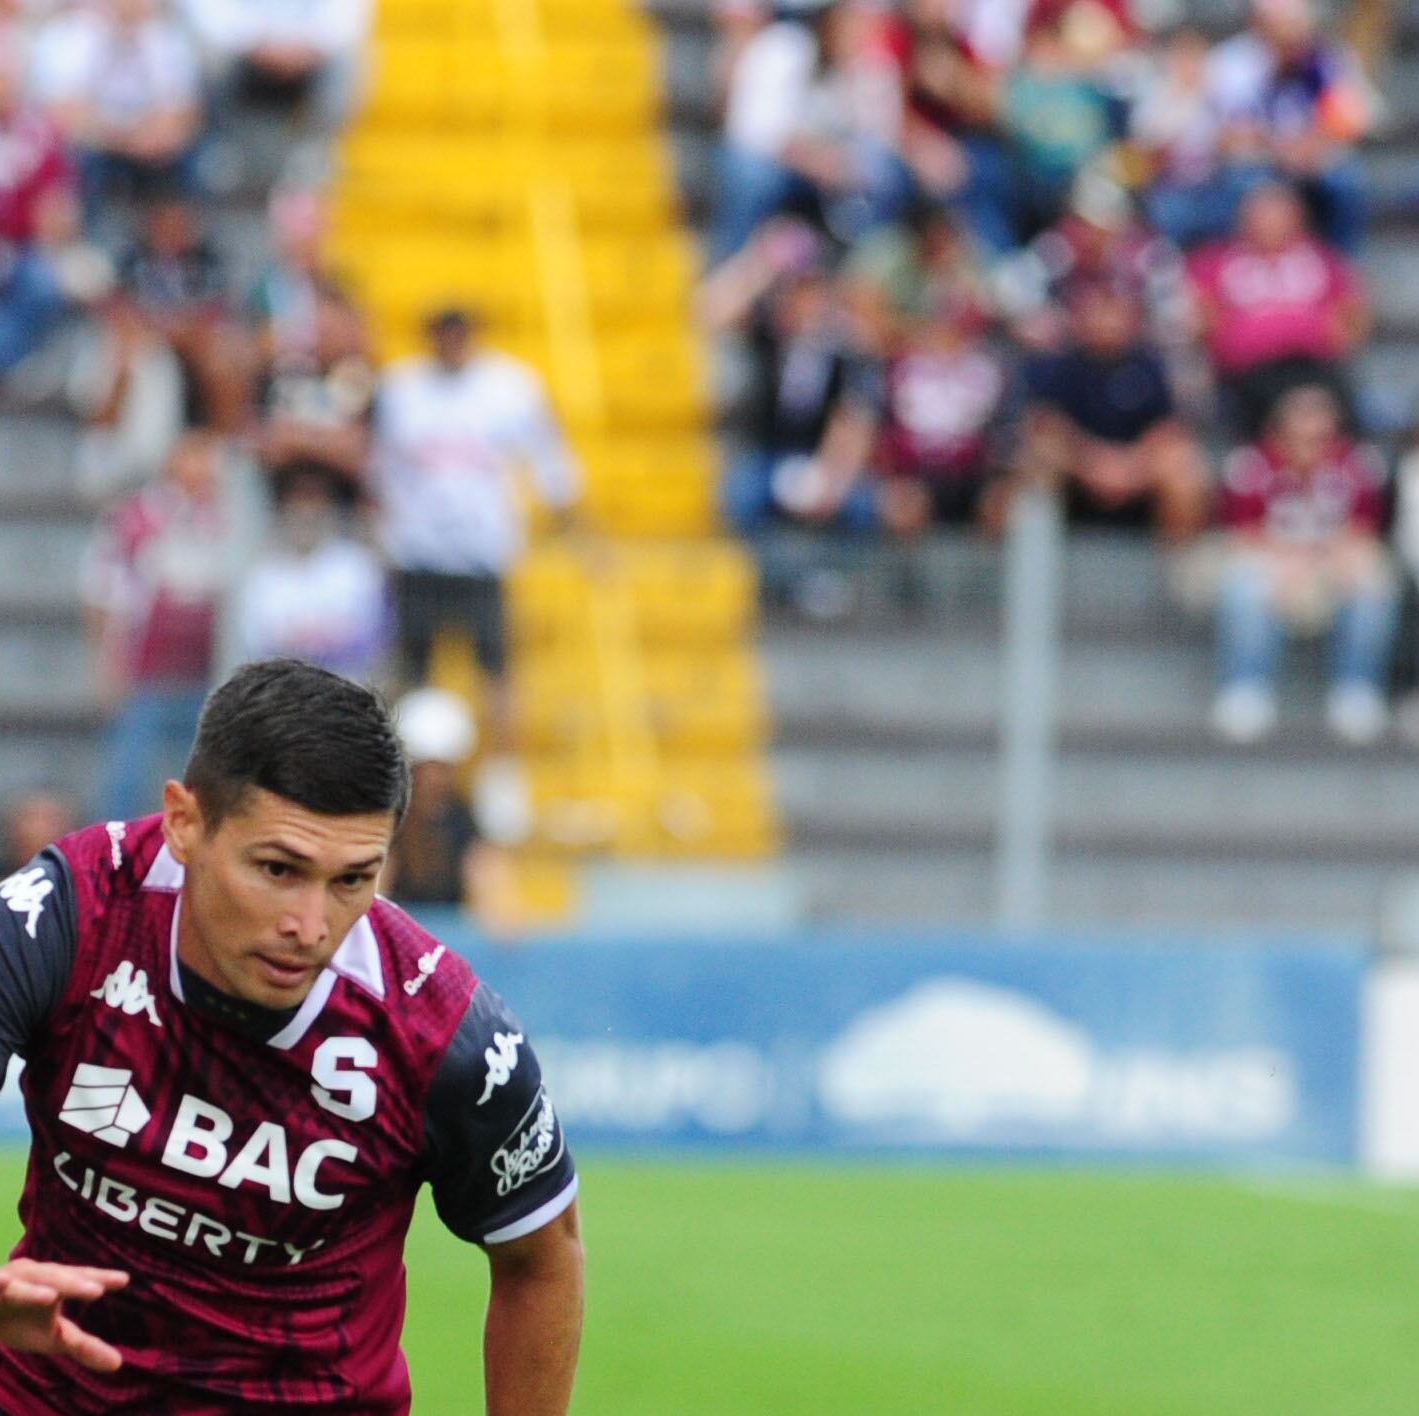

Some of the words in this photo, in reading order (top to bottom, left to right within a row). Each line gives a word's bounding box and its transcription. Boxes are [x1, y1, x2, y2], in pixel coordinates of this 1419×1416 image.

[310, 1036, 378, 1122] S
[53, 1151, 326, 1266] LIBERTY
[161, 1093, 359, 1210] BAC
